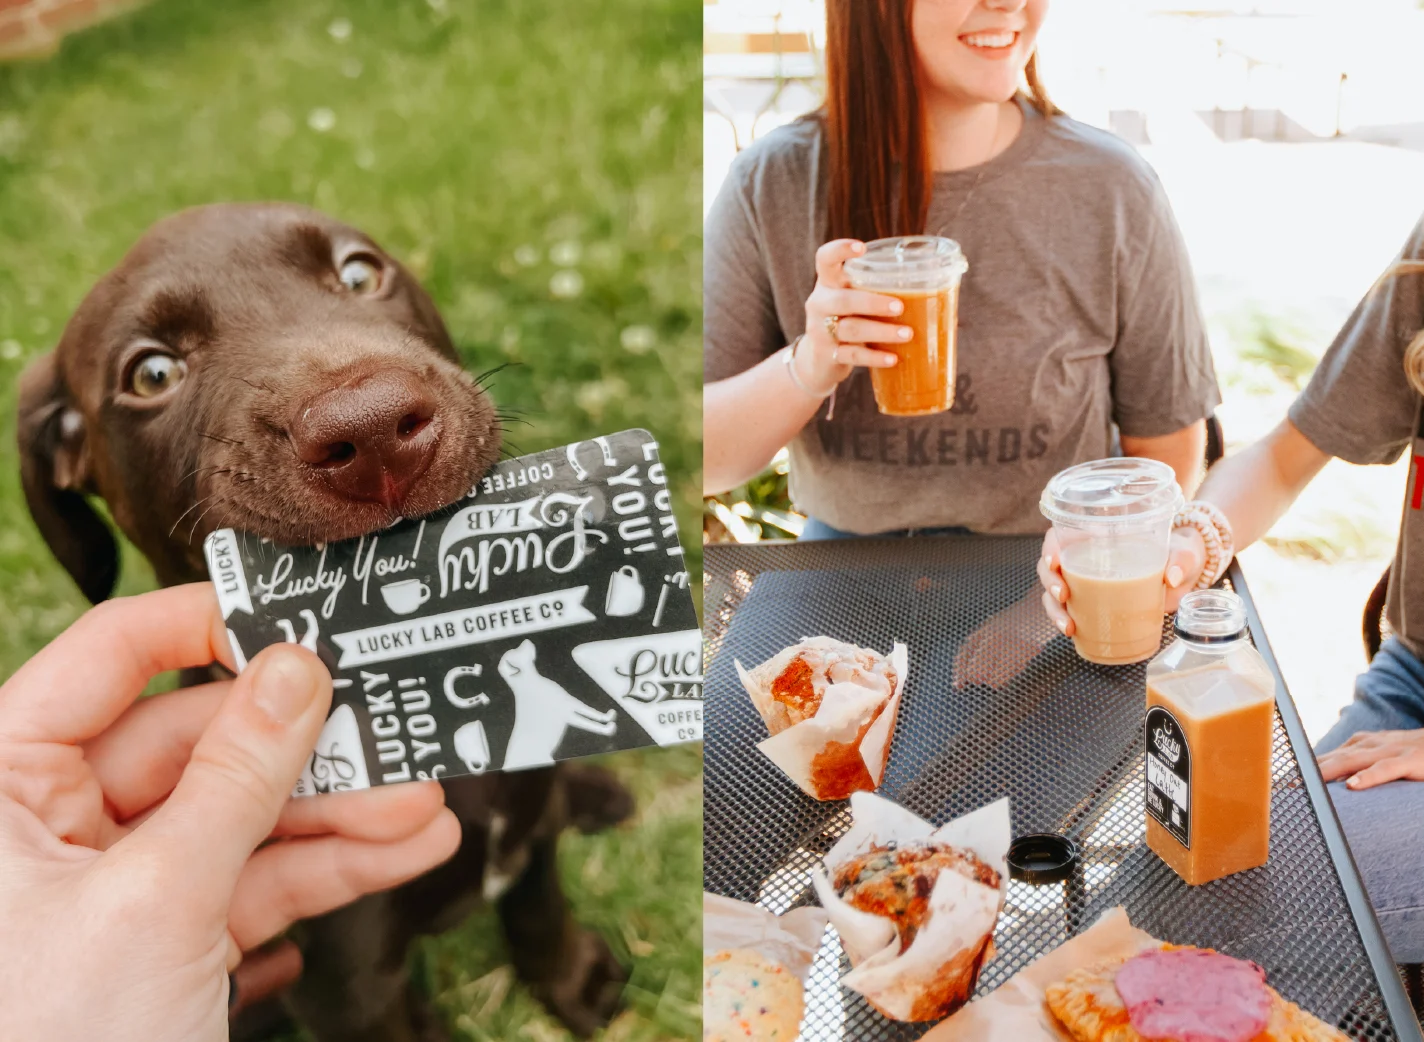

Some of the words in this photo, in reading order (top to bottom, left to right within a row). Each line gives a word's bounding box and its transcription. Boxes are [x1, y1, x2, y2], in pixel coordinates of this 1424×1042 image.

[949, 373, 979, 416] &
[817, 422, 1050, 468] WEEKENDS
[483, 461, 554, 495] COFFEE
[466, 505, 524, 531] LAB
[607, 464, 658, 556] YOU!
[214, 534, 240, 595] LUCKY
[257, 543, 347, 620] Lucky
[352, 519, 426, 606] You!
[438, 491, 610, 600] Lucky
[356, 623, 415, 655] LUCKY
[422, 622, 456, 643] LAB
[463, 605, 535, 634] COFFEE
[613, 641, 703, 704] Luc
[359, 670, 412, 784] LUCKY
[397, 676, 442, 764] YOU!
[1152, 727, 1181, 757] Lucky
